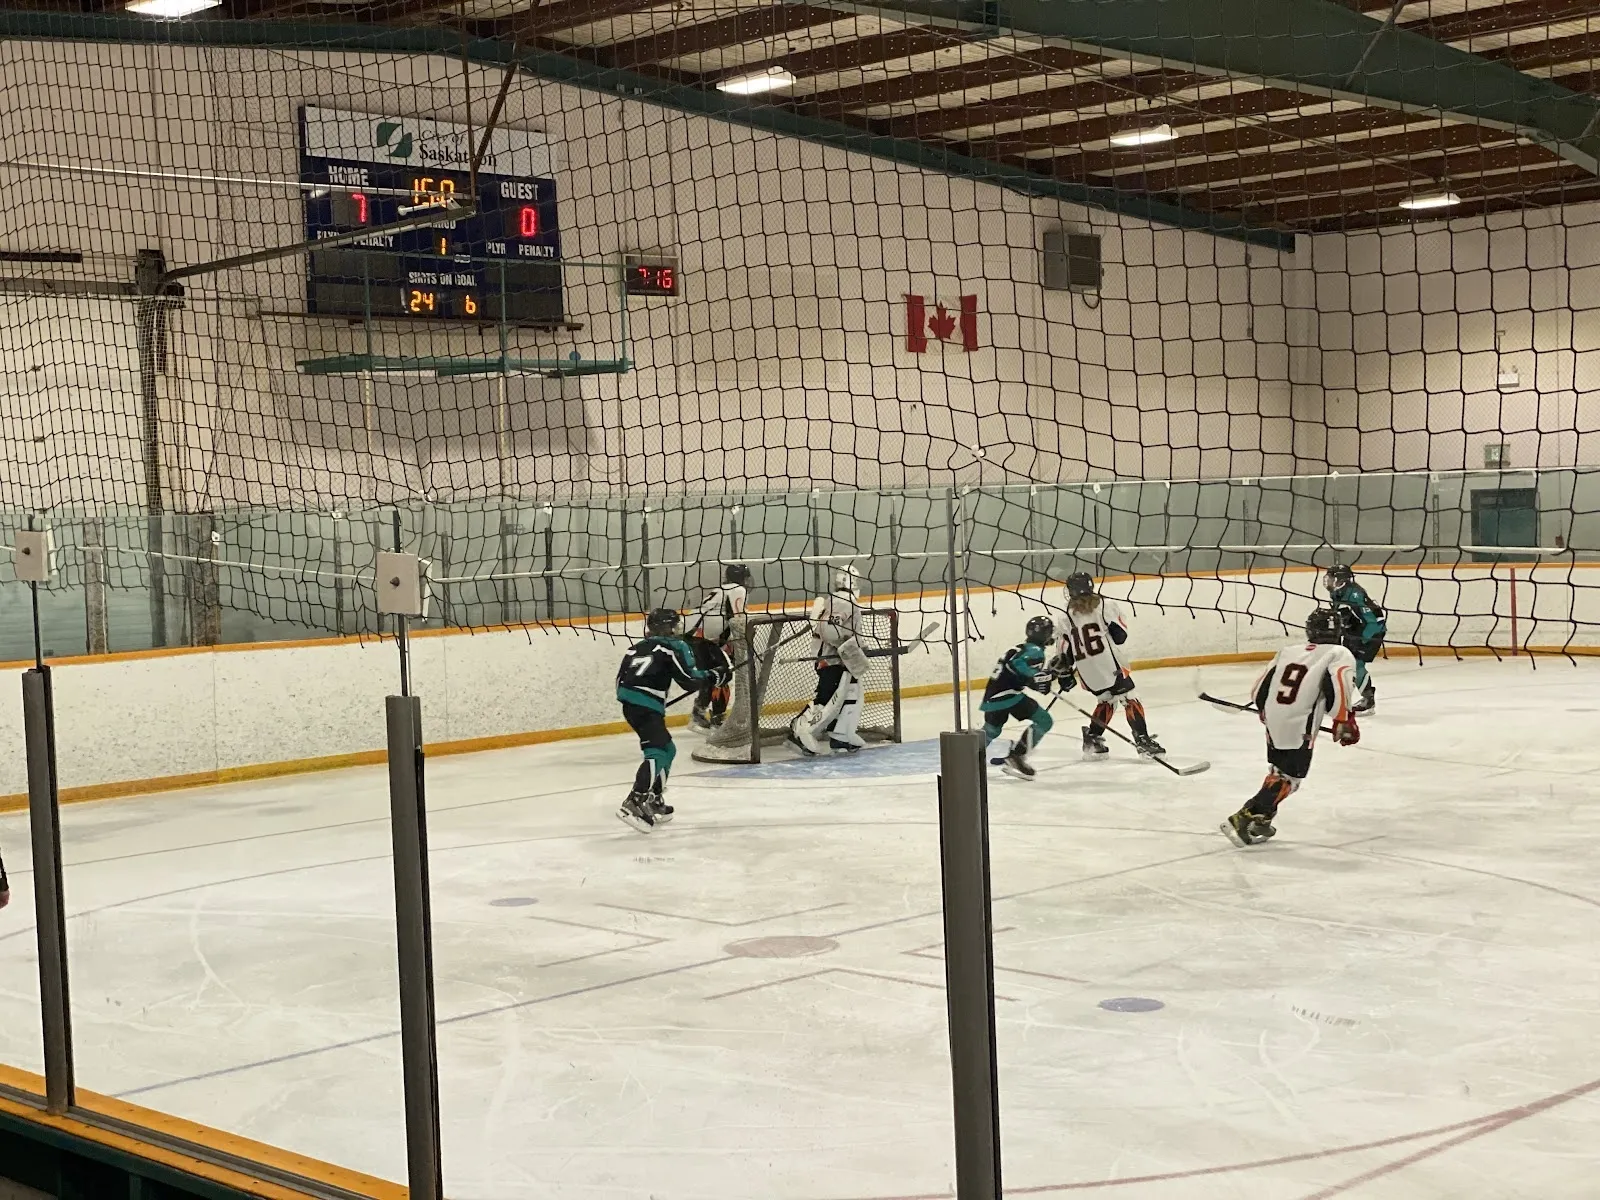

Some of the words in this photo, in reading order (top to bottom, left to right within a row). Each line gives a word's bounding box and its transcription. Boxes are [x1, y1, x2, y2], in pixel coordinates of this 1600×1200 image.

[419, 143, 497, 167] Saskaton
[328, 165, 369, 186] HOME
[501, 182, 538, 200] GUEST
[352, 193, 367, 223] 7
[522, 207, 535, 237] 0
[354, 235, 394, 248] ENALTY
[441, 237, 447, 256] 1
[409, 271, 437, 285] SHOTS
[440, 273, 452, 286] ON
[455, 273, 477, 287] GOAL
[638, 268, 672, 289] 7:16
[410, 290, 434, 312] 24
[1071, 622, 1105, 661] 16
[630, 655, 653, 676] 7
[1276, 662, 1309, 705] 9
